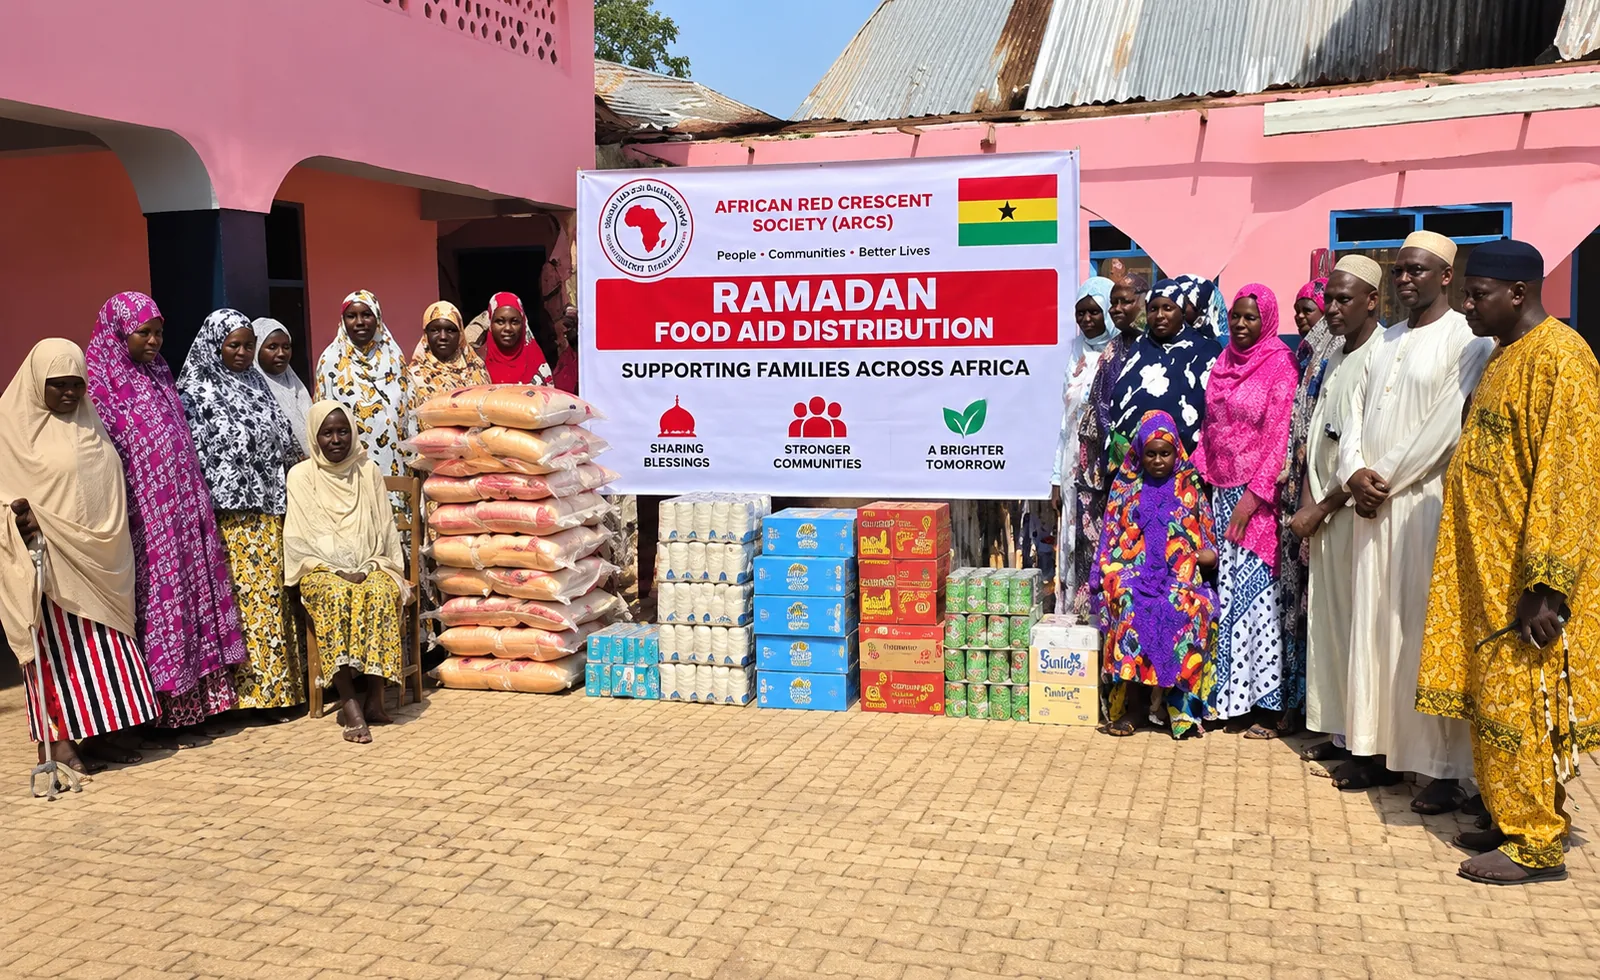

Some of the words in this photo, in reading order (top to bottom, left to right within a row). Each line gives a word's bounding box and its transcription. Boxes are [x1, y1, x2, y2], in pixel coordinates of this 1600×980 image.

[715, 198, 793, 214] AFRICAN
[798, 196, 834, 212] RED
[837, 193, 933, 210] CRESCENT
[752, 217, 828, 233] SOCIETY
[832, 214, 894, 233] (ARCS)
[717, 249, 757, 262] People
[768, 247, 846, 260] Communities
[859, 246, 897, 258] Better
[899, 245, 931, 257] Lives
[712, 276, 937, 314] RAMADAN
[655, 320, 731, 343] FOOD
[736, 320, 786, 342] AID
[793, 316, 994, 342] DISTRIBUTION
[621, 361, 751, 379] SUPPORTING
[757, 361, 850, 378] FAMILIES
[855, 360, 944, 377] ACROSS
[949, 359, 1030, 377] AFRICA
[650, 443, 704, 454] SHARING
[784, 444, 851, 455] STRONGER
[927, 445, 937, 455] A
[940, 445, 1004, 456] BRIGHTER
[643, 457, 710, 468] BLESSINGS
[773, 458, 862, 469] COMMUNITIES
[925, 459, 1006, 470] TOMORROW
